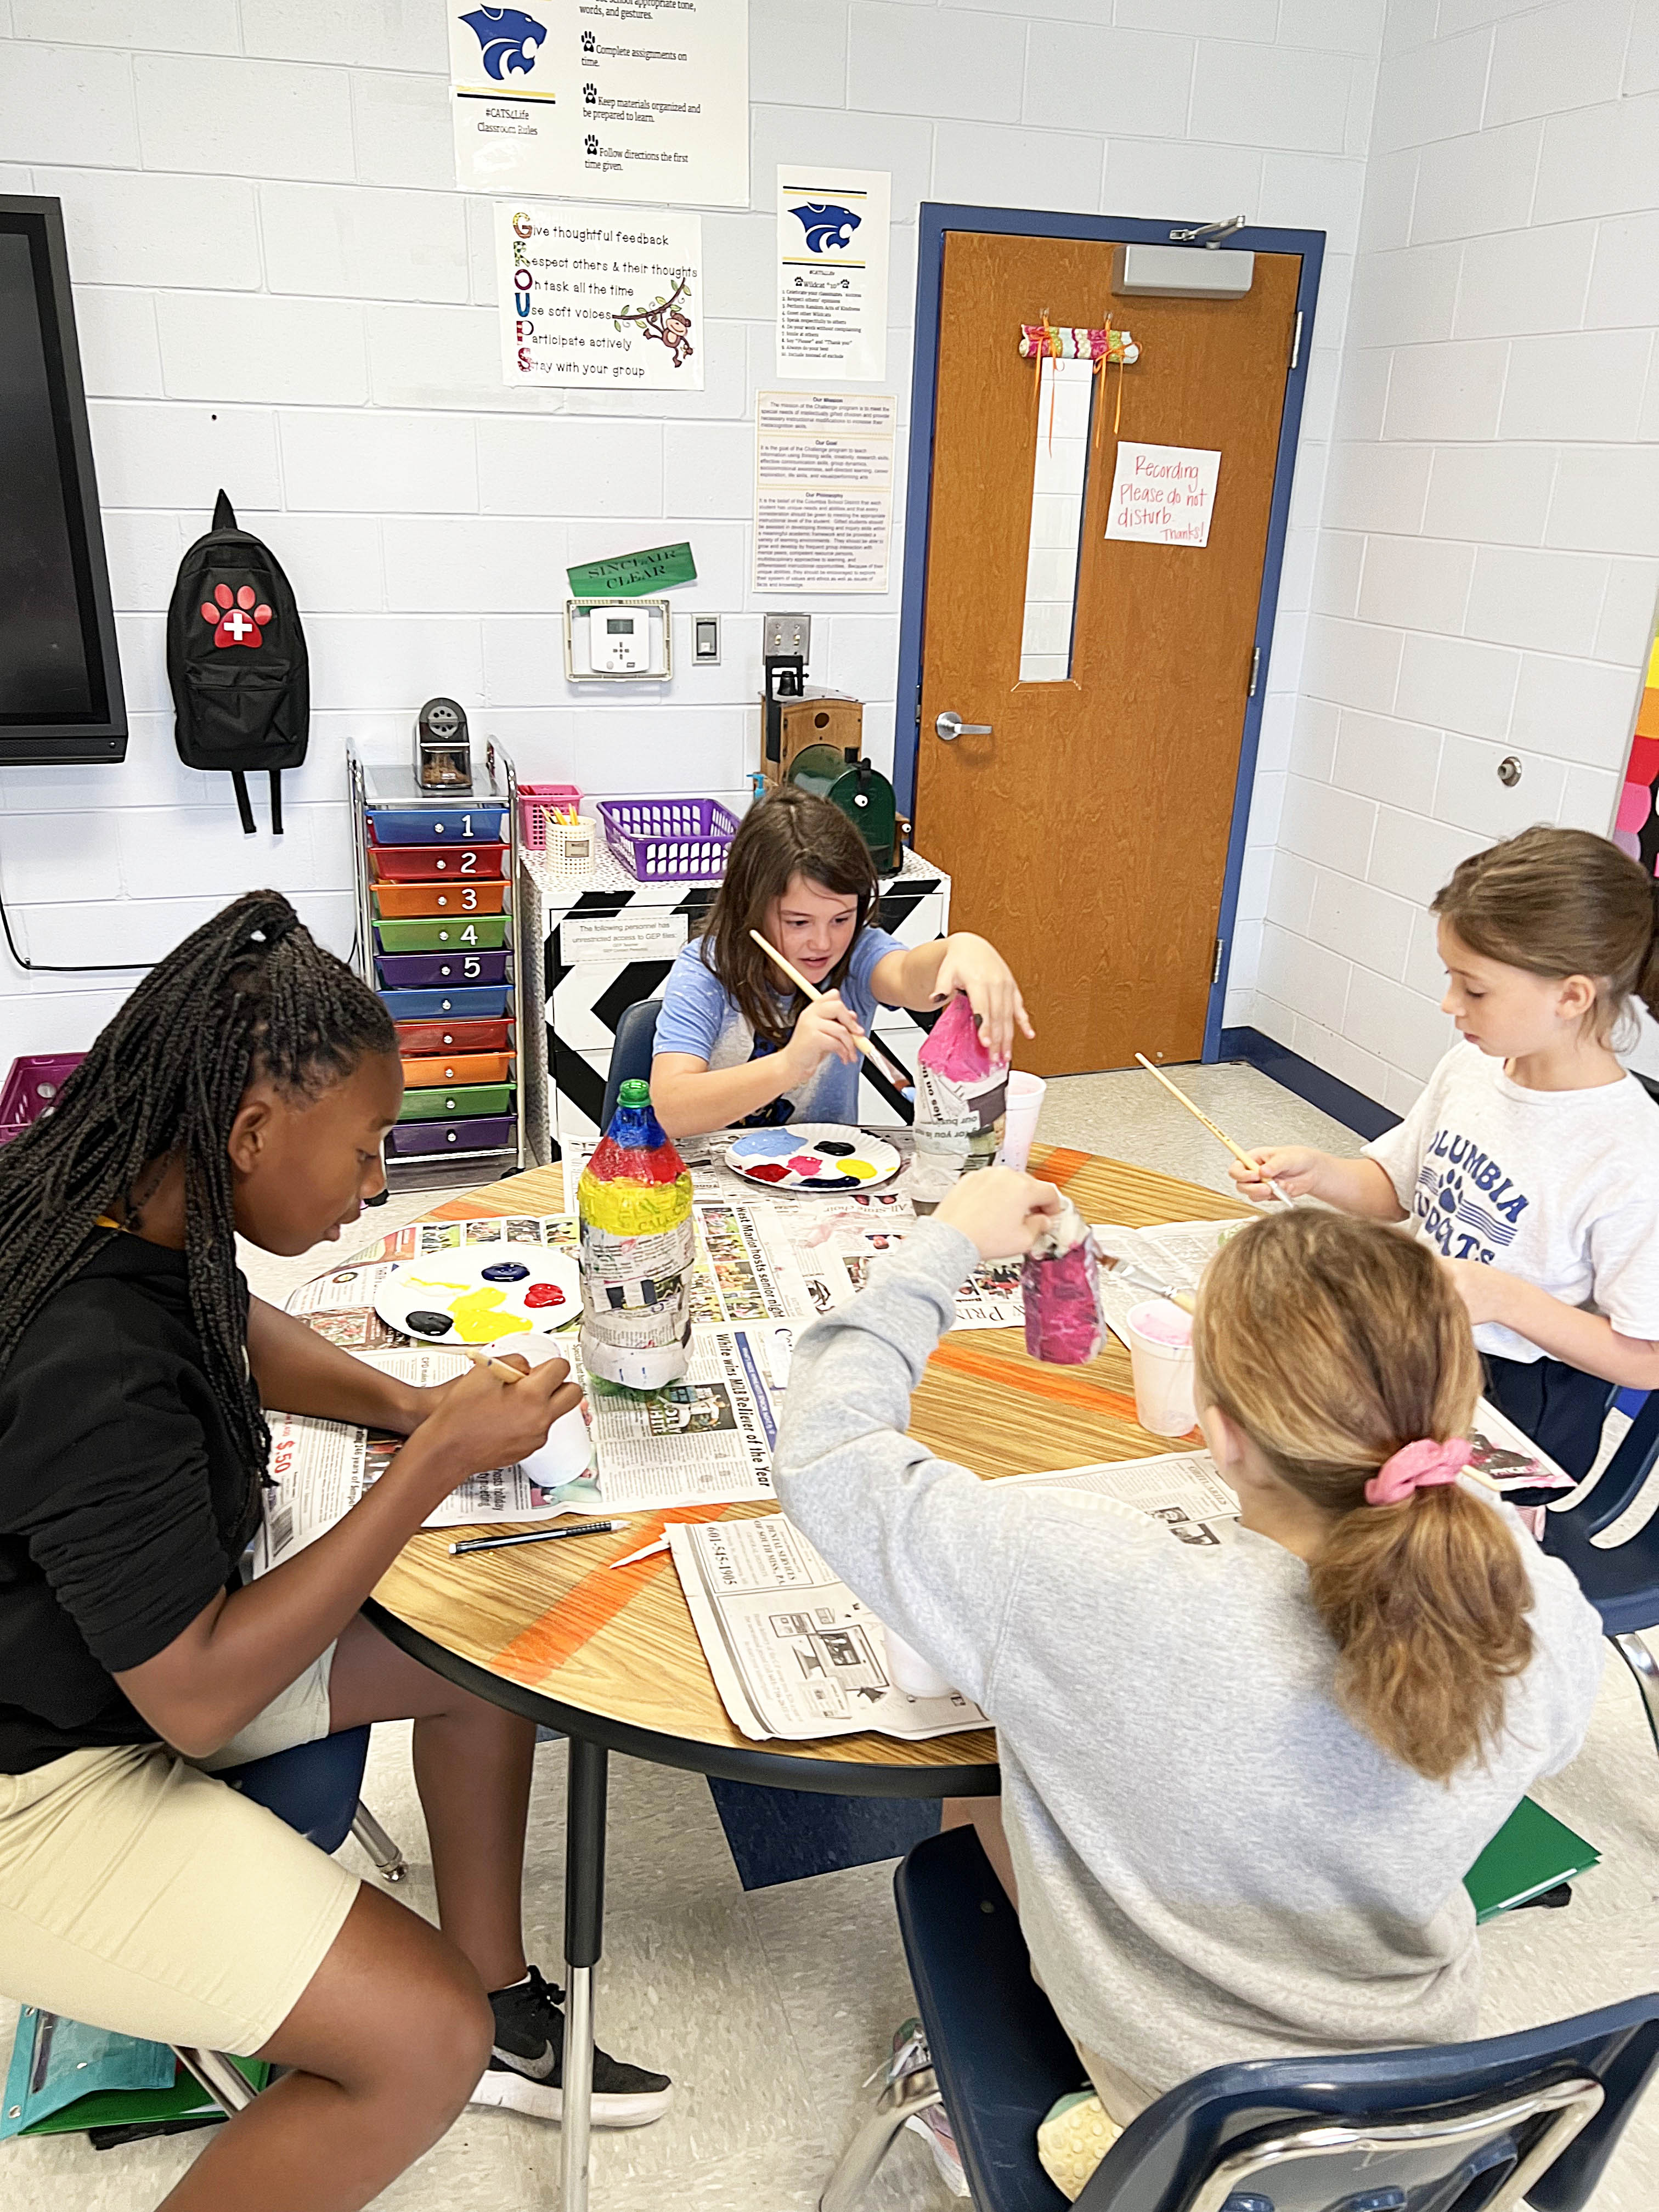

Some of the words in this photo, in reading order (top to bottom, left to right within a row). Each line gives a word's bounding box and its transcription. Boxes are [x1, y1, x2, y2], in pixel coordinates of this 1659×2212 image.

[579, 5, 605, 17] words,
[606, 7, 619, 16] and
[621, 9, 653, 20] gestures.
[678, 1, 696, 12] tone,
[596, 44, 630, 57] Complete
[632, 48, 676, 60] assignments
[583, 108, 591, 117] be
[593, 110, 624, 121] prepared
[598, 97, 616, 109] Keep
[617, 99, 650, 109] materials
[652, 102, 686, 113] organized
[688, 104, 701, 113] and
[478, 122, 516, 133] Classroom
[518, 125, 538, 135] Rules
[585, 159, 601, 168] time
[599, 148, 623, 157] Follow
[624, 149, 659, 160] directions
[661, 152, 672, 161] the
[674, 153, 689, 162] first
[553, 226, 613, 242] thoughtful
[616, 231, 669, 246] feedback
[513, 241, 568, 269] Respect
[573, 258, 608, 270] others
[612, 262, 619, 272] &
[623, 262, 648, 273] their
[651, 264, 697, 279] thoughts
[544, 280, 568, 292] task
[573, 282, 586, 294] all
[589, 283, 606, 295] the
[610, 284, 634, 296] time
[515, 292, 544, 317] Use
[549, 307, 571, 317] soft
[575, 308, 611, 319] voices
[516, 320, 585, 347] Participate
[590, 336, 632, 351] actively
[556, 362, 579, 373] with
[583, 365, 608, 375] your
[613, 366, 645, 379] group
[1136, 455, 1199, 493] Recording
[1120, 483, 1164, 505] Please
[1167, 488, 1181, 505] do
[1187, 489, 1207, 506] not
[1118, 506, 1171, 527] disturb
[1160, 522, 1204, 543] Thanks!
[588, 550, 676, 579] SINCLAIR
[607, 566, 666, 589] CLEAR
[461, 815, 474, 837] 1
[461, 853, 476, 873] 2
[461, 889, 477, 910] 3
[460, 924, 478, 945] 4
[464, 957, 481, 978] 5
[736, 1207, 751, 1222] West
[751, 1249, 766, 1272] hosts
[759, 1274, 775, 1297] senior
[716, 1333, 733, 1356] White
[421, 1357, 430, 1368] CPD
[723, 1359, 739, 1376] wins
[735, 1397, 754, 1431] Reliever
[354, 1445, 364, 1455] 246
[746, 1435, 763, 1444] of
[274, 1440, 296, 1474] $.50
[749, 1448, 766, 1463] the
[755, 1466, 771, 1487] Year
[492, 1488, 506, 1511] holiday
[754, 1520, 764, 1529] OF
[759, 1531, 773, 1553] SOUTH
[766, 1525, 783, 1548] DENTAL
[706, 1527, 737, 1585] 601-545-1905
